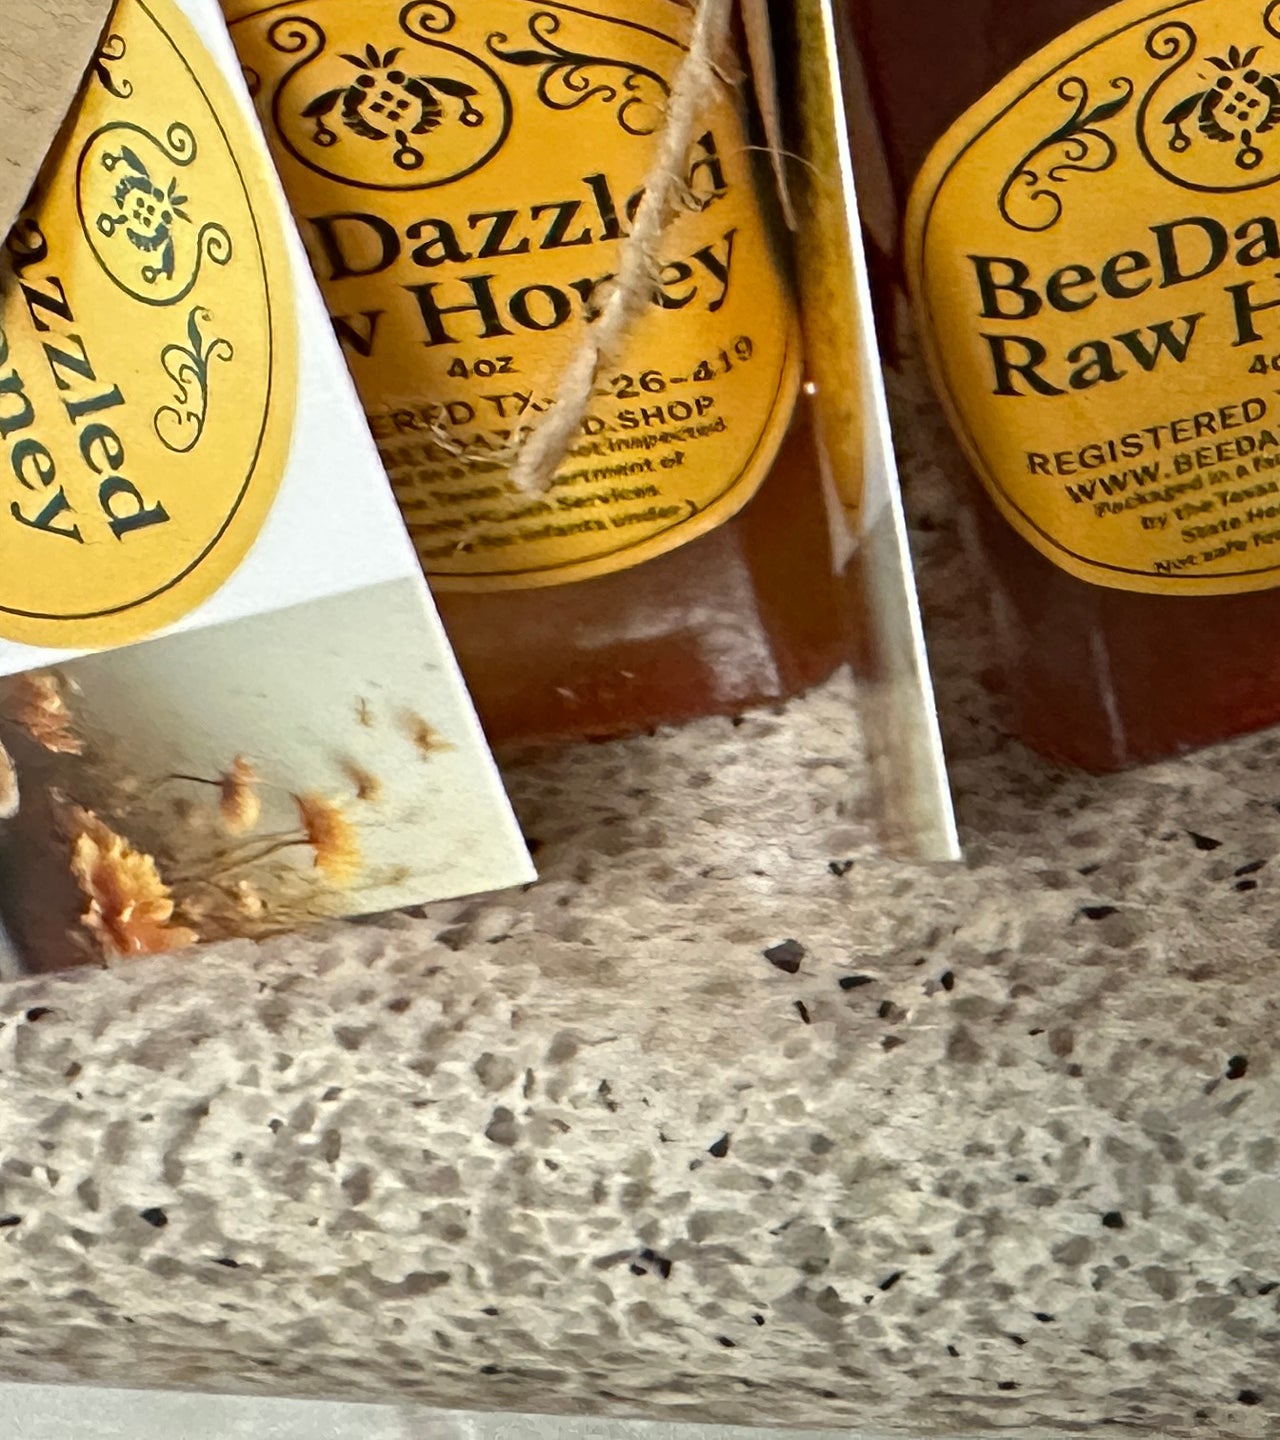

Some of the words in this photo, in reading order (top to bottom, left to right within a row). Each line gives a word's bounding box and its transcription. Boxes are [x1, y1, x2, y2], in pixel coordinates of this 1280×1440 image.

[446, 356, 518, 379] 4oz
[977, 312, 1207, 398] Raw
[1026, 397, 1268, 476] REGISTERED
